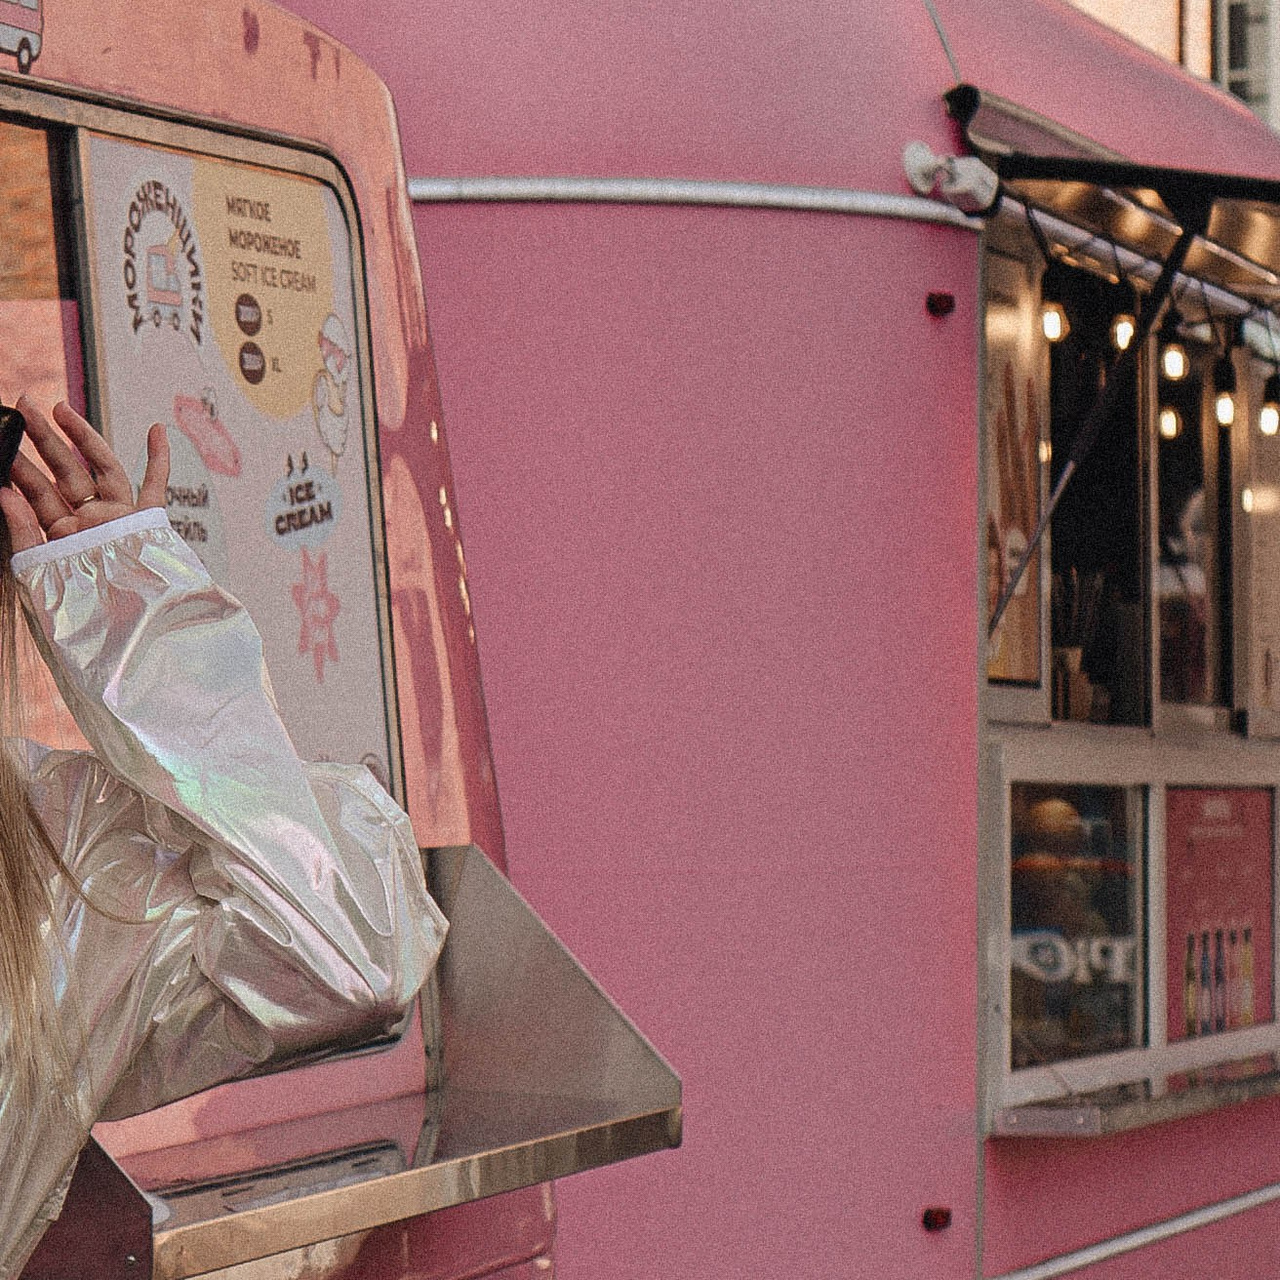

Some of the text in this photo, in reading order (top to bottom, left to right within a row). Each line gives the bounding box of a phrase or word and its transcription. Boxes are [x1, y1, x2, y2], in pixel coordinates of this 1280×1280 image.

[228, 227, 302, 259] МОРОЖЕНОЕ
[231, 260, 317, 294] SOFT ICE CREAM
[288, 480, 316, 506] ICE
[275, 500, 334, 536] CREAM
